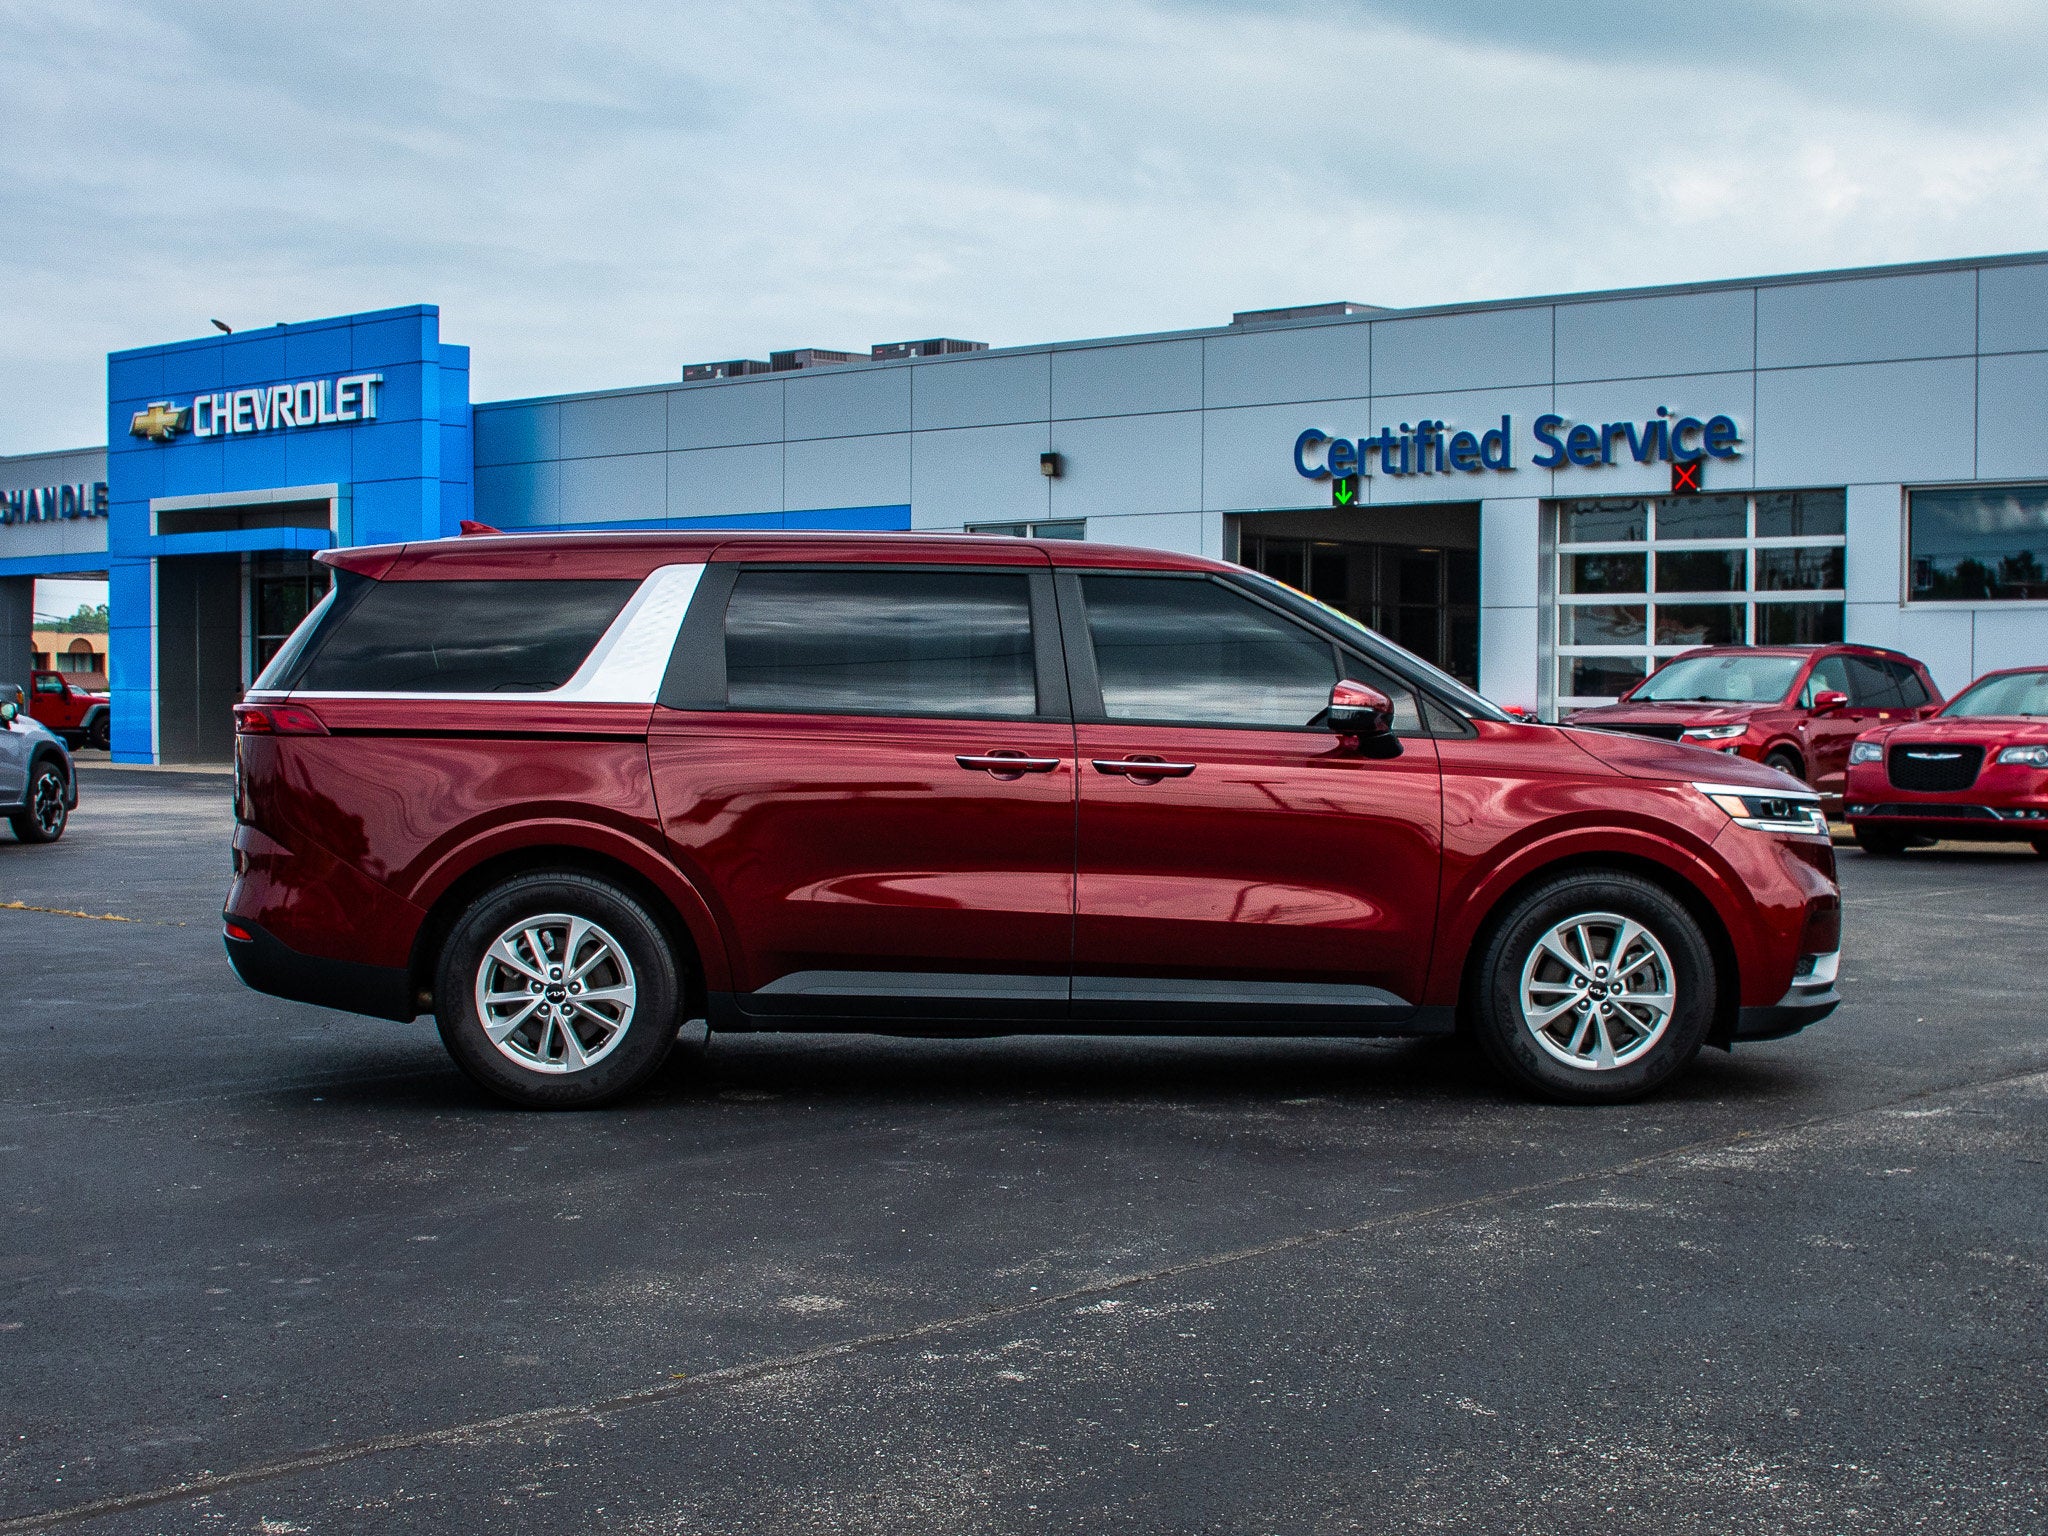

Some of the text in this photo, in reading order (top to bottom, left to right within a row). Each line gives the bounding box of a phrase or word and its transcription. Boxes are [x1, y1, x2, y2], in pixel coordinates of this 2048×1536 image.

[193, 373, 382, 437] CHEVROLET
[1294, 406, 1740, 479] Certified Service
